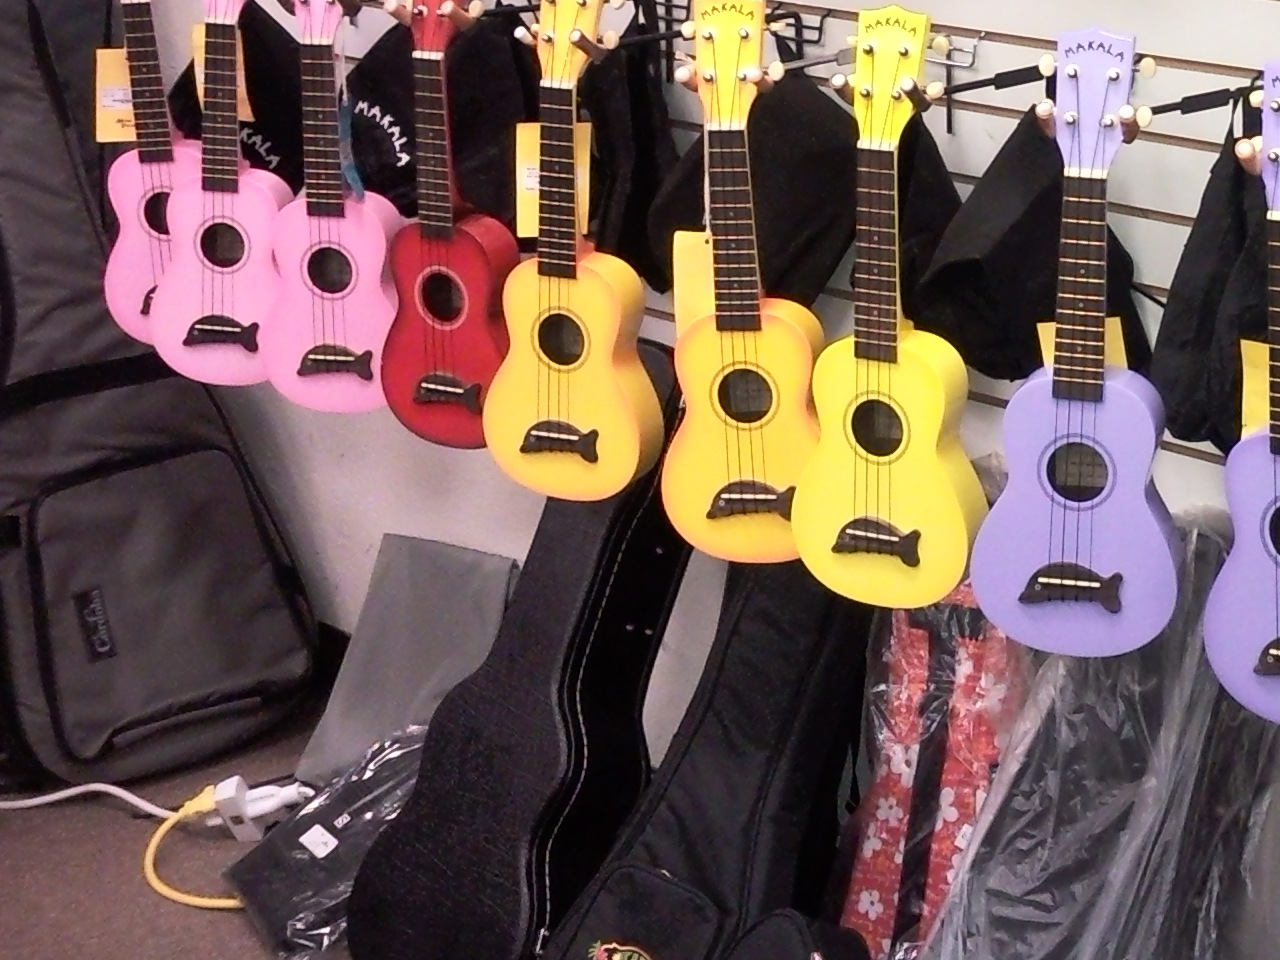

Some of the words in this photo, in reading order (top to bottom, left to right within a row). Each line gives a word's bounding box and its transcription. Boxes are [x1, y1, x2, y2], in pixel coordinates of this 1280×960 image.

[700, 2, 756, 21] MAKALA
[864, 16, 918, 38] MAKALA
[1064, 40, 1125, 63] MAKALA
[353, 99, 411, 168] MAKALA
[239, 126, 281, 170] KALA
